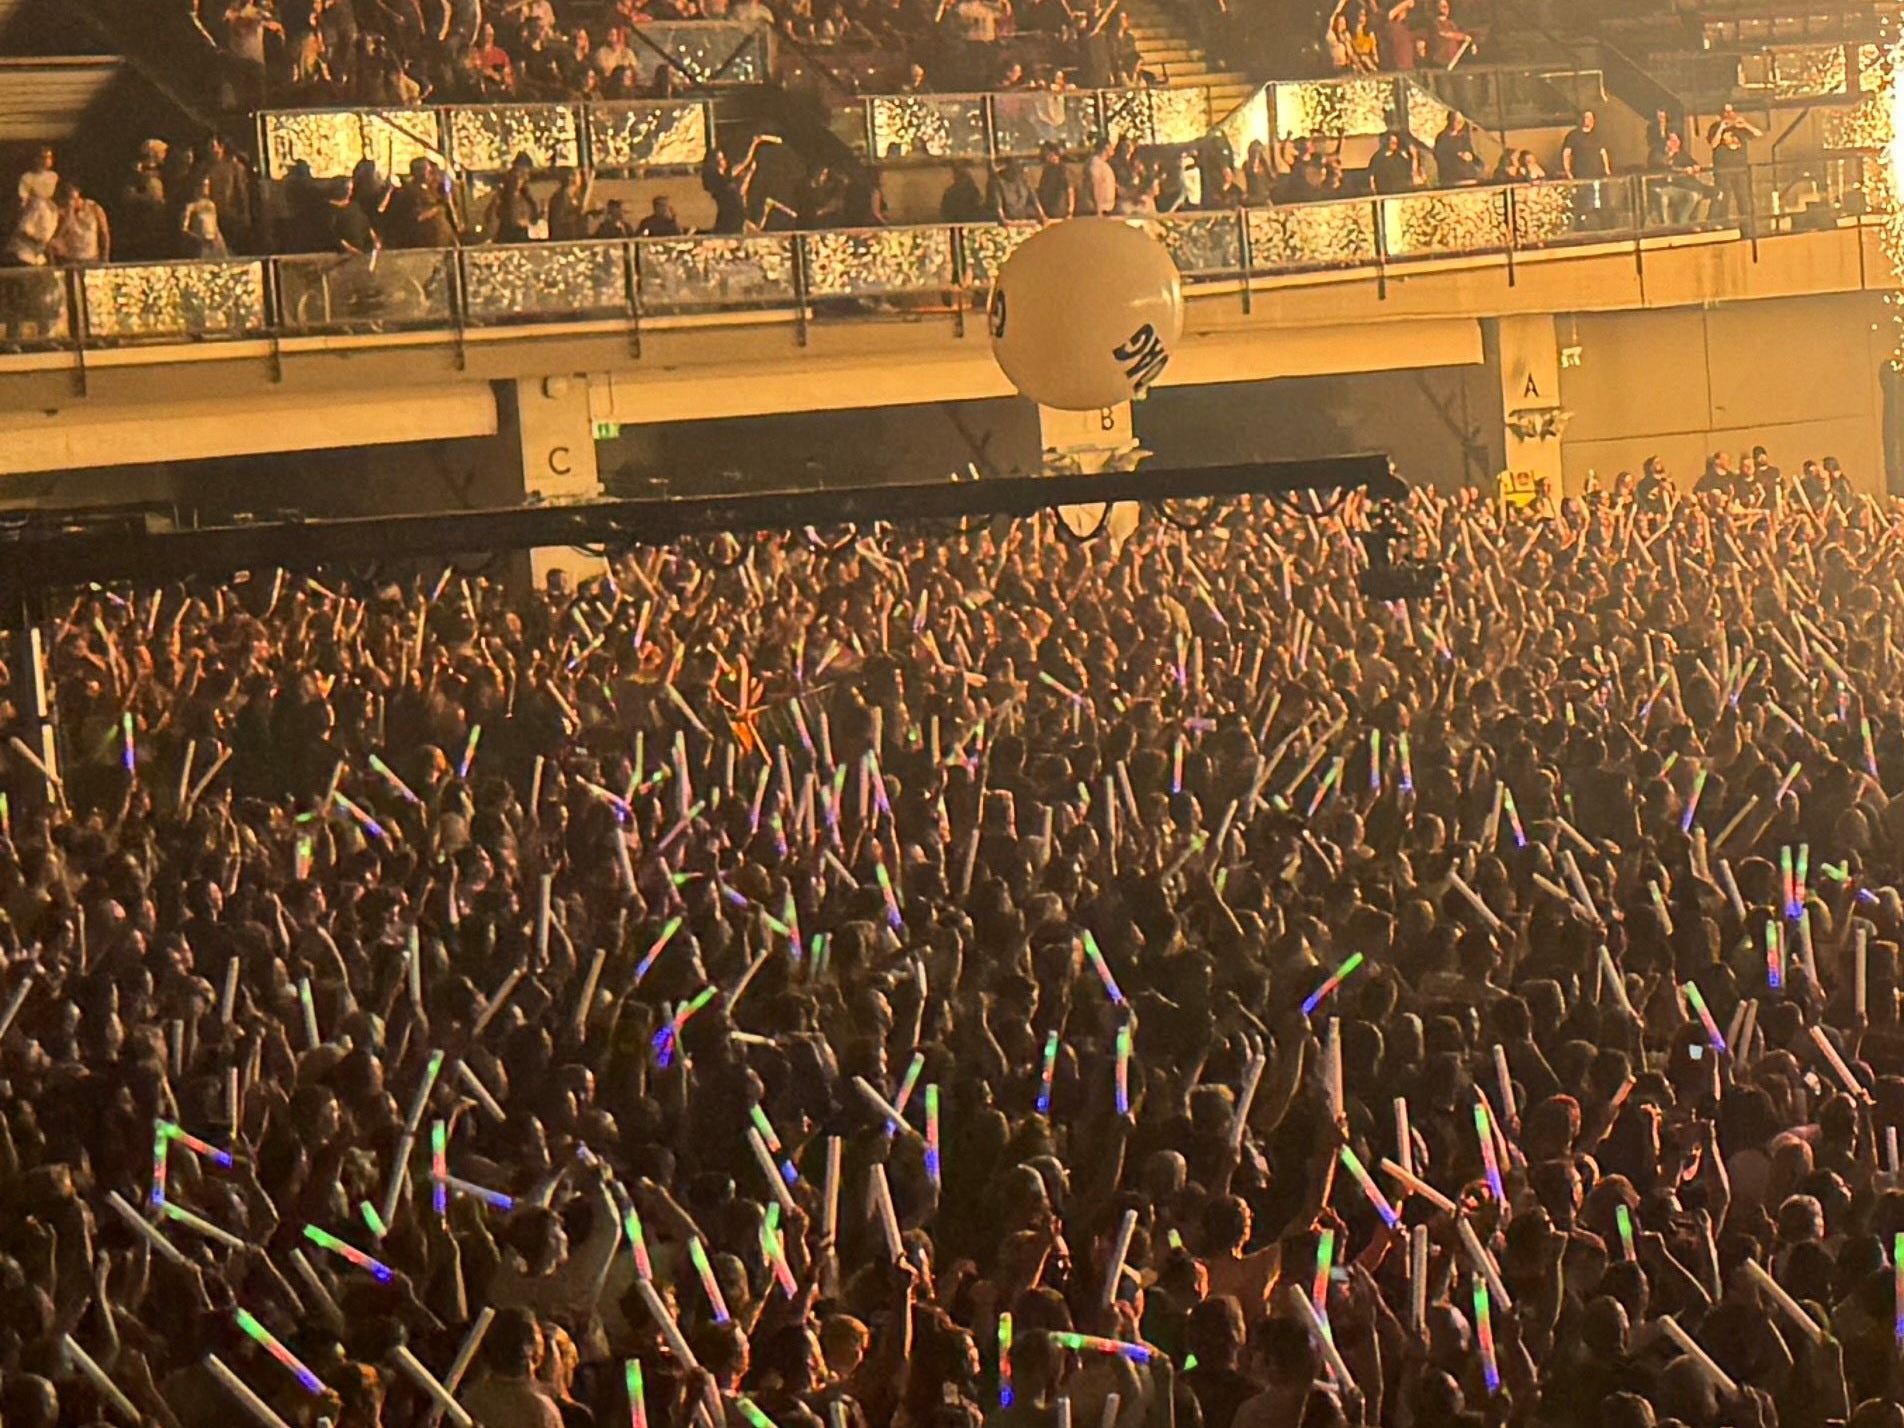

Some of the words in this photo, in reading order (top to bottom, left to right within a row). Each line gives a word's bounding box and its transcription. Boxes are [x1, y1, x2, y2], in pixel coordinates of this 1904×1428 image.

[1524, 373, 1539, 397] A
[1101, 406, 1114, 430] B
[548, 447, 571, 475] C
